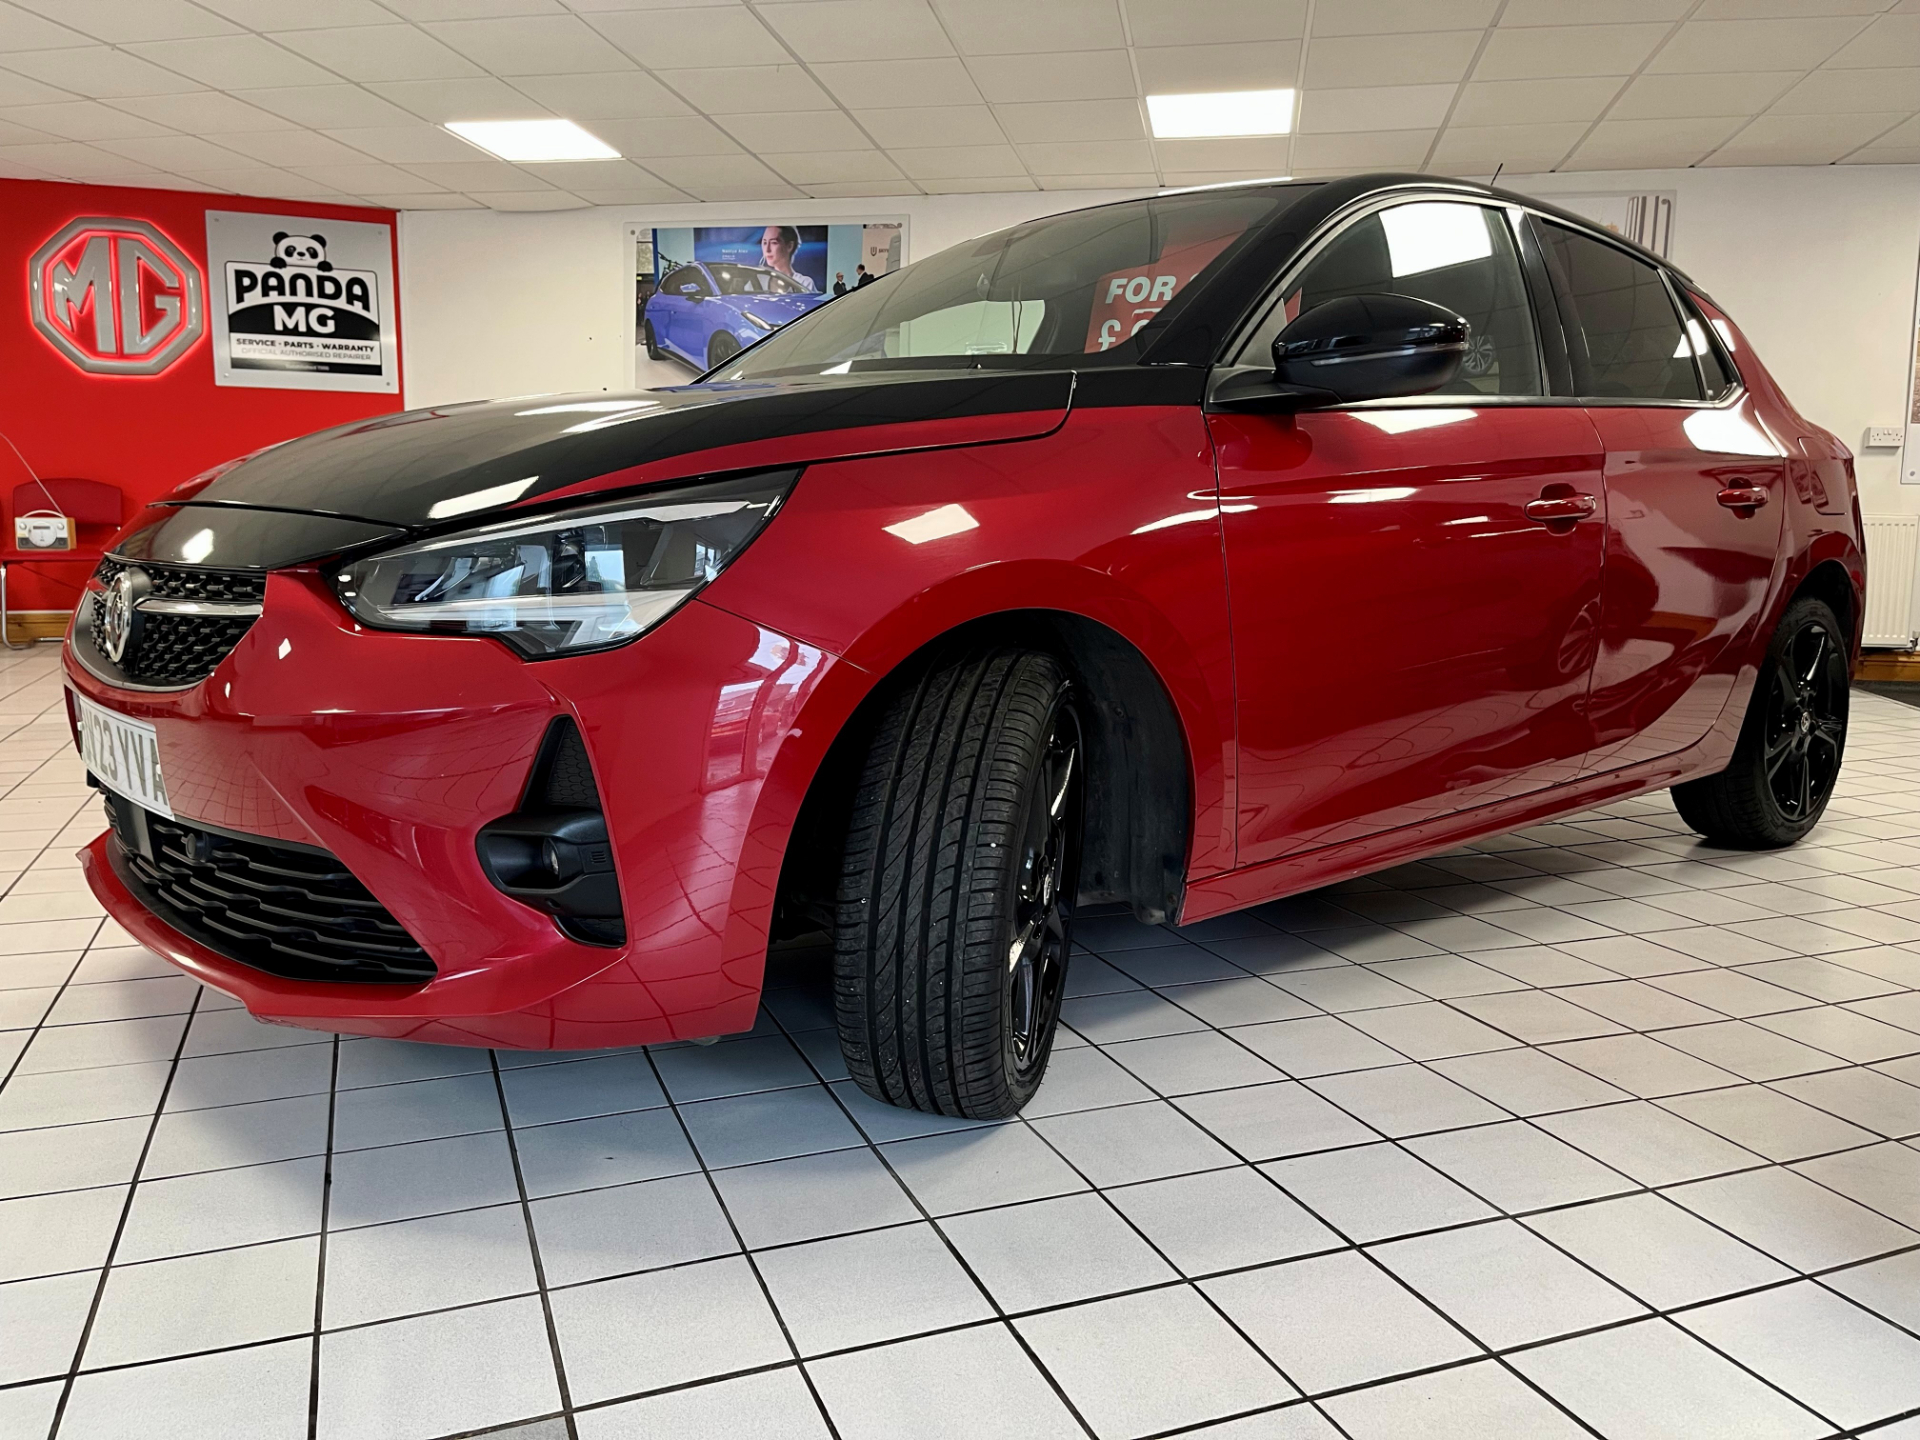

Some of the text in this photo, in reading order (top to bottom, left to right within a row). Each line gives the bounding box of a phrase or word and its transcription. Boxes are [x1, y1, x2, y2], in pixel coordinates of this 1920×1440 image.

[52, 236, 182, 356] MG
[234, 269, 371, 314] PANDA
[1105, 275, 1177, 304] FOR
[273, 305, 335, 334] MG
[236, 338, 375, 353] SERVICE PARTS WARRANTY
[241, 347, 371, 361] OFFICIAL AUTHORISED REPAIRER
